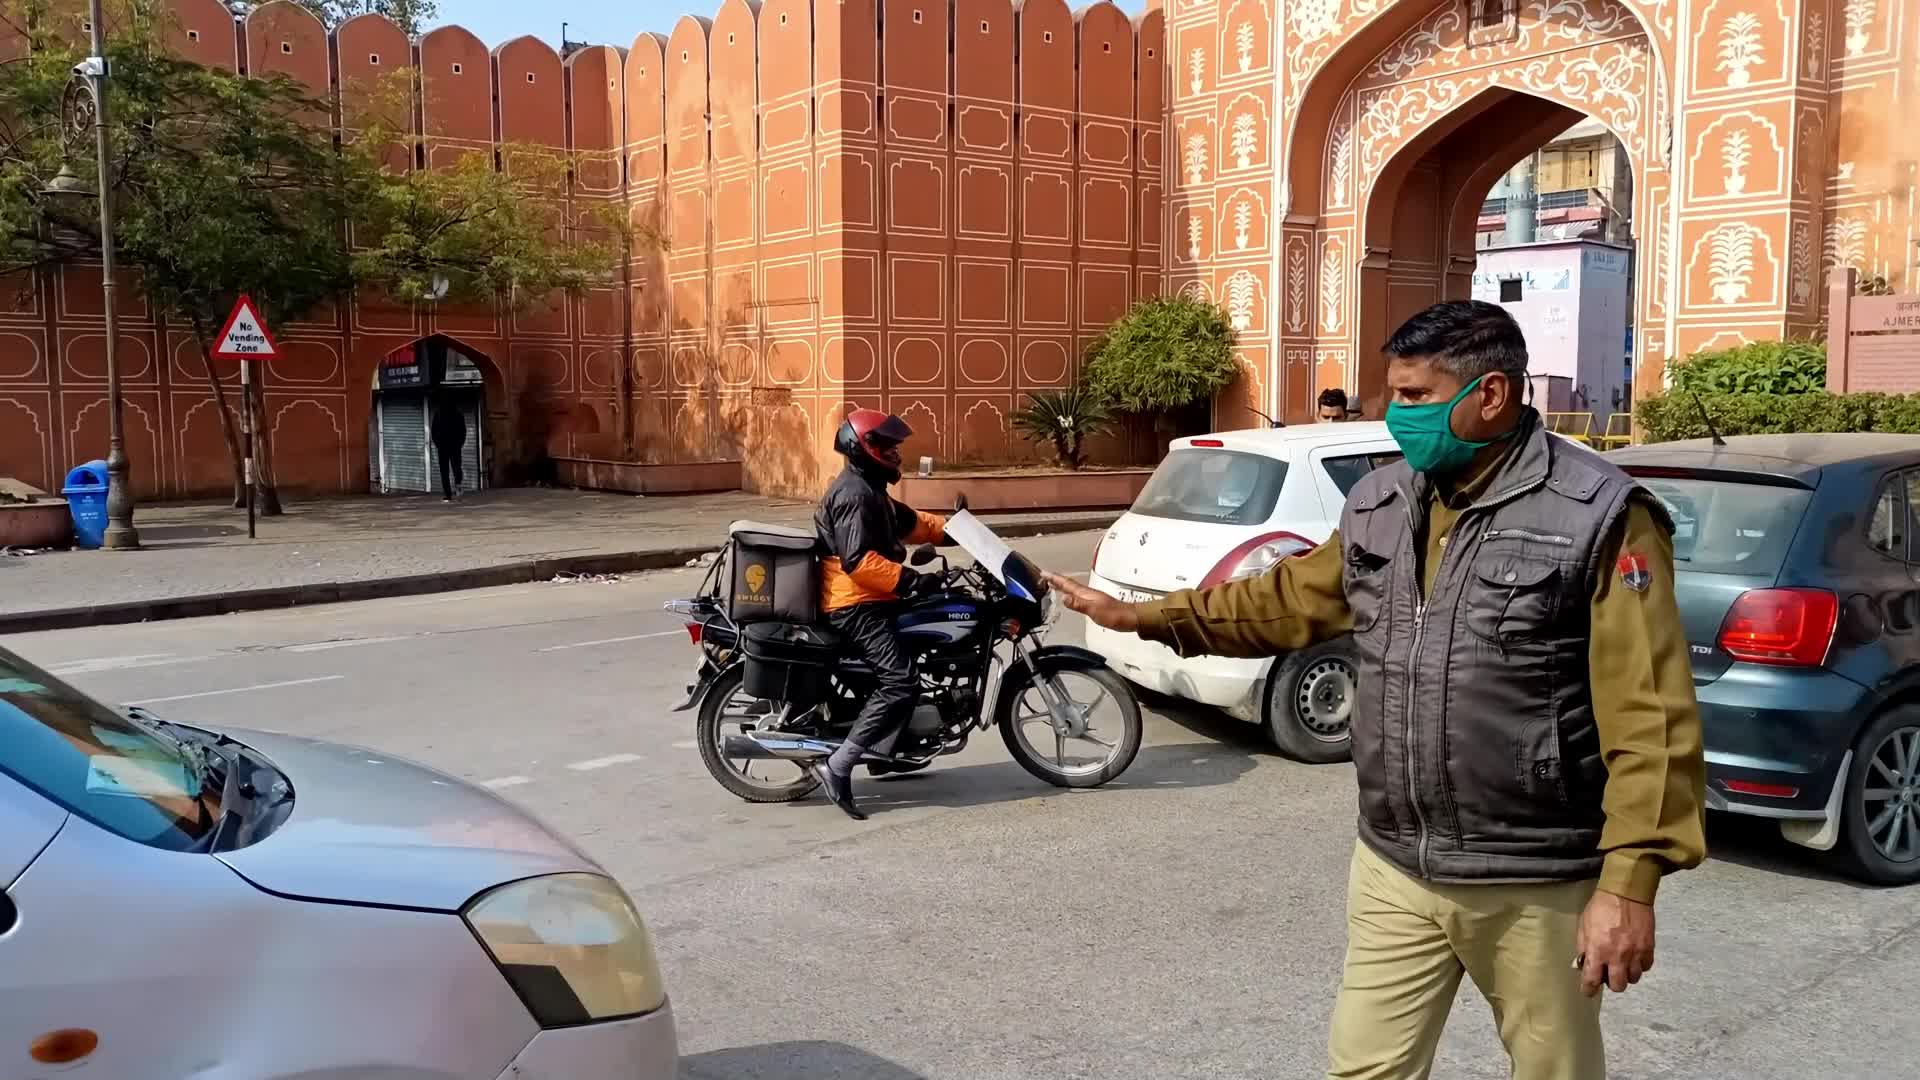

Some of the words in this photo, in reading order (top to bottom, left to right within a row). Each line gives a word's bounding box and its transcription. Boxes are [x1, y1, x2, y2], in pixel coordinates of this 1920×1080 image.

[240, 322, 252, 331] No
[229, 333, 264, 344] Vending
[236, 343, 258, 352] Zone
